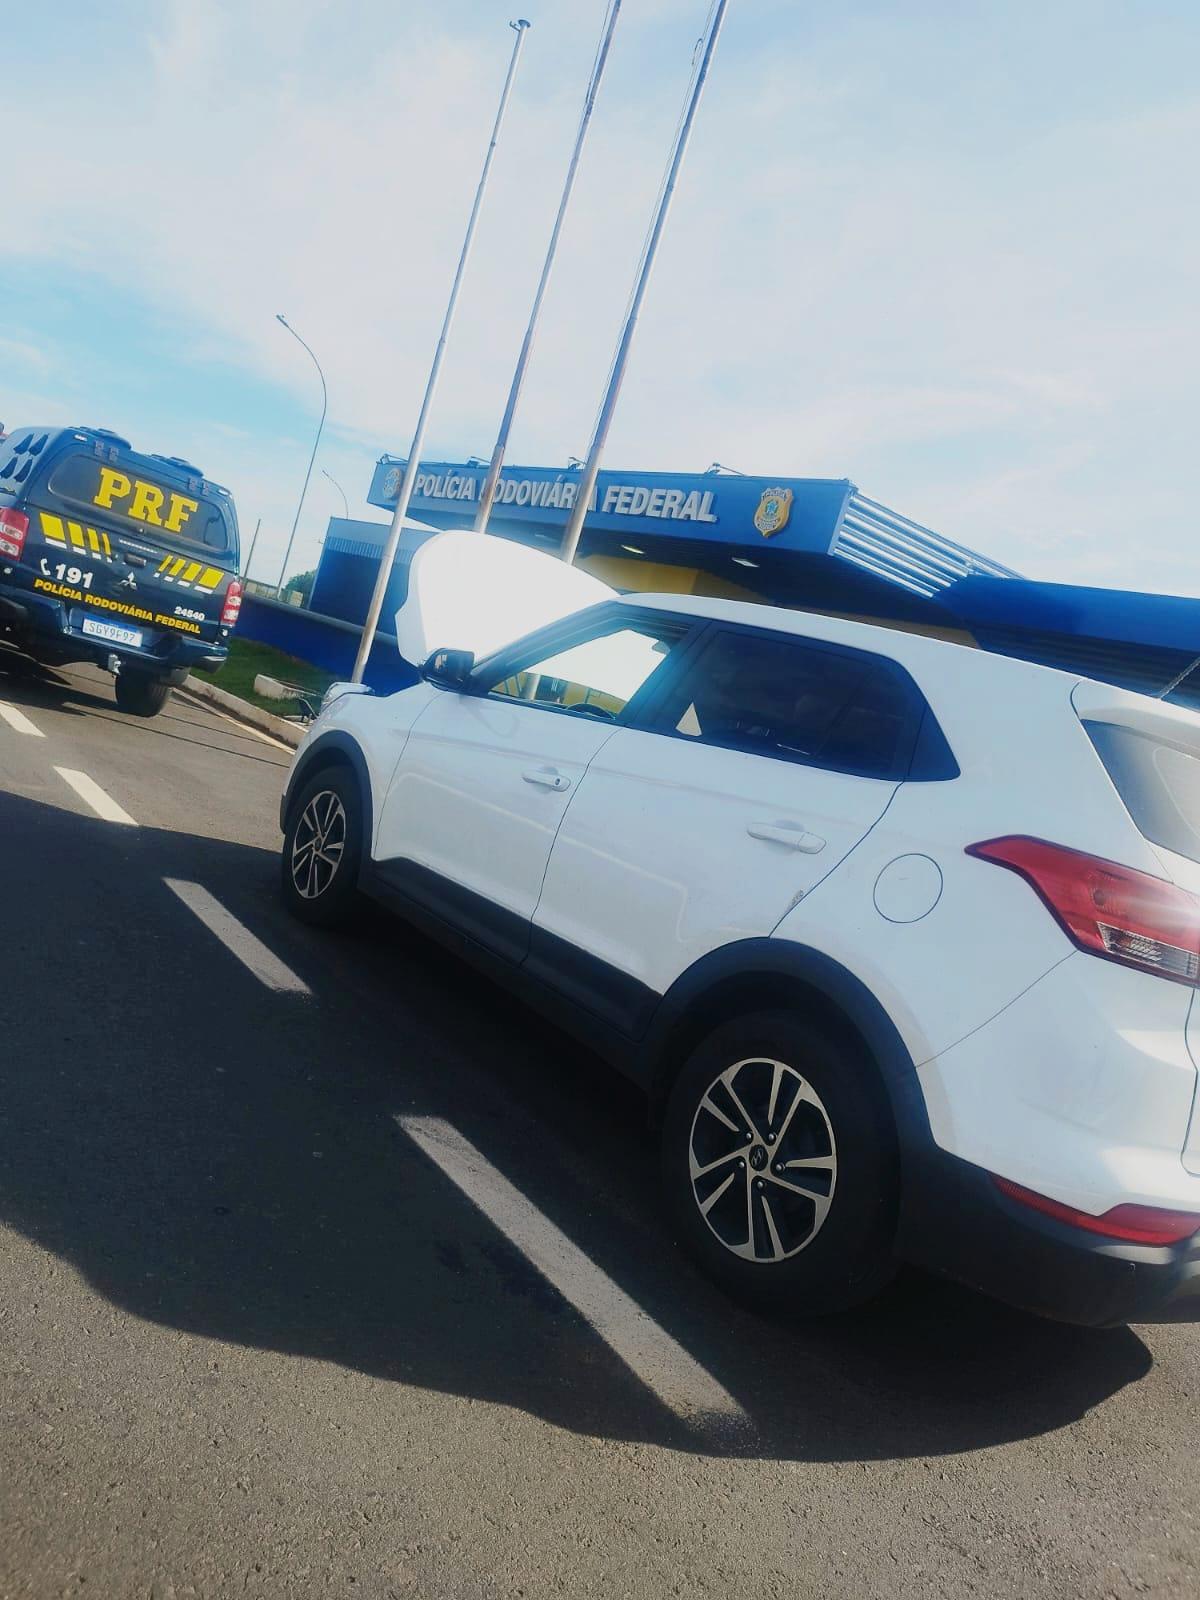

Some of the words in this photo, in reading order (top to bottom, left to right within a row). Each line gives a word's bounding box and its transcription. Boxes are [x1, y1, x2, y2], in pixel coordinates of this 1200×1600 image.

[93, 467, 199, 532] PRF
[414, 470, 475, 500] POLÍCIA
[479, 475, 597, 512] ODOVIÁR
[601, 485, 717, 523] FEDERAL
[55, 563, 94, 589] 191
[34, 578, 82, 600] POLÍCIA
[84, 593, 153, 621] RODOVIÁRIA
[154, 614, 201, 634] FEDERAL
[174, 606, 206, 621] 24540
